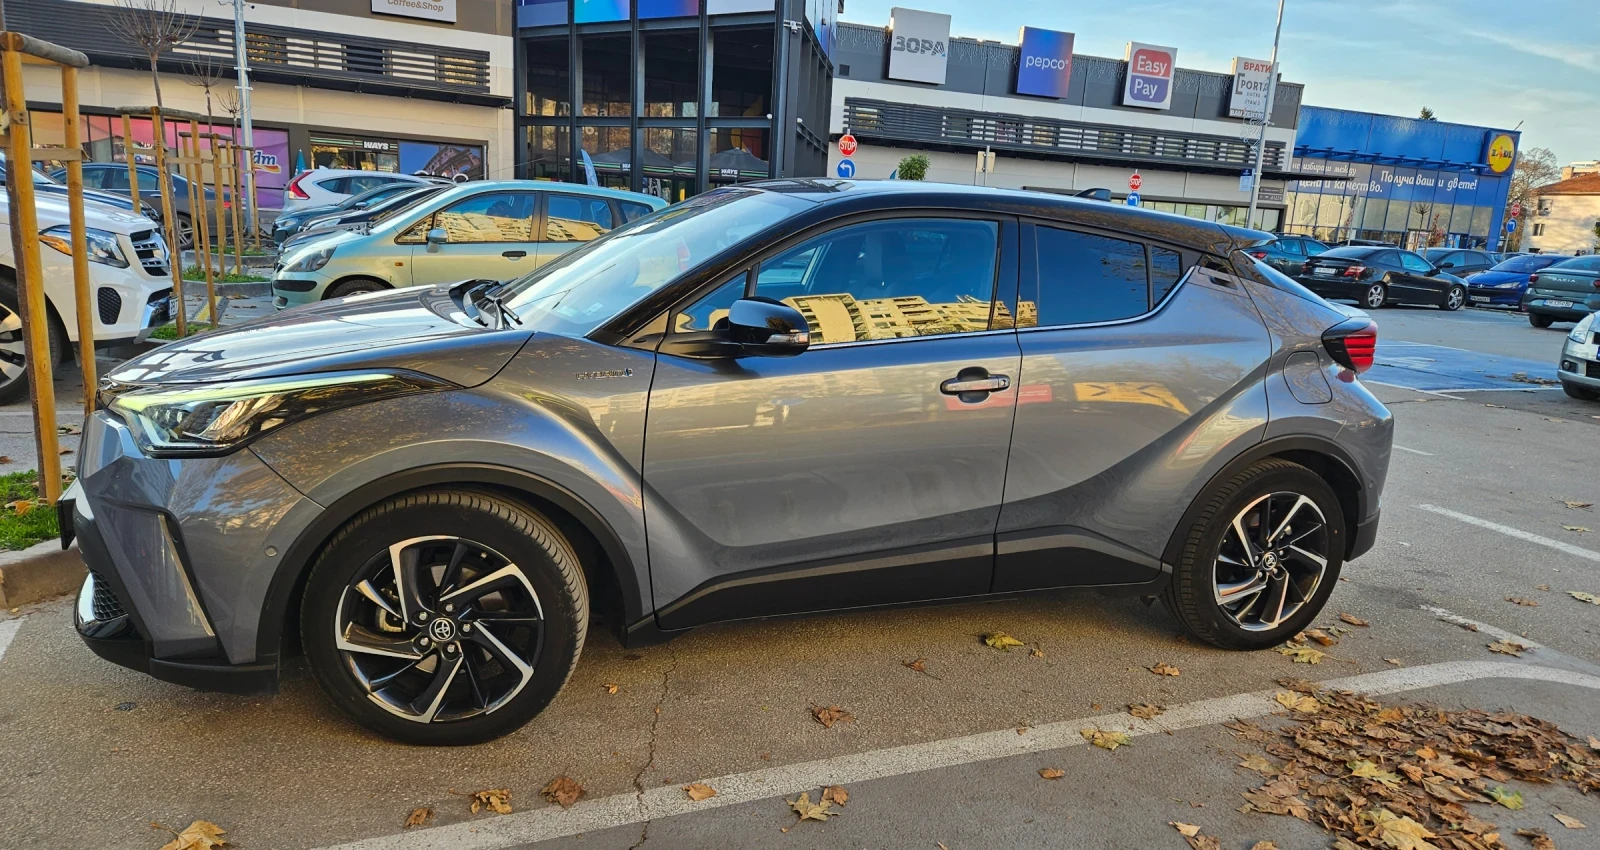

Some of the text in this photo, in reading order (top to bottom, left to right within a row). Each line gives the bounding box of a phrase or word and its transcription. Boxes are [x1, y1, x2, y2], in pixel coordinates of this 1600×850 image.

[893, 35, 946, 57] ЗОРА
[1136, 55, 1168, 76] Easy
[1243, 61, 1272, 73] ВРАТИ
[1133, 78, 1158, 99] Pay
[363, 141, 389, 150] WAYS
[840, 141, 856, 151] STOP
[253, 151, 276, 165] dm
[1302, 162, 1332, 173] избираш
[1333, 165, 1357, 177] между
[1437, 179, 1444, 187] и
[1447, 177, 1478, 191] двете!
